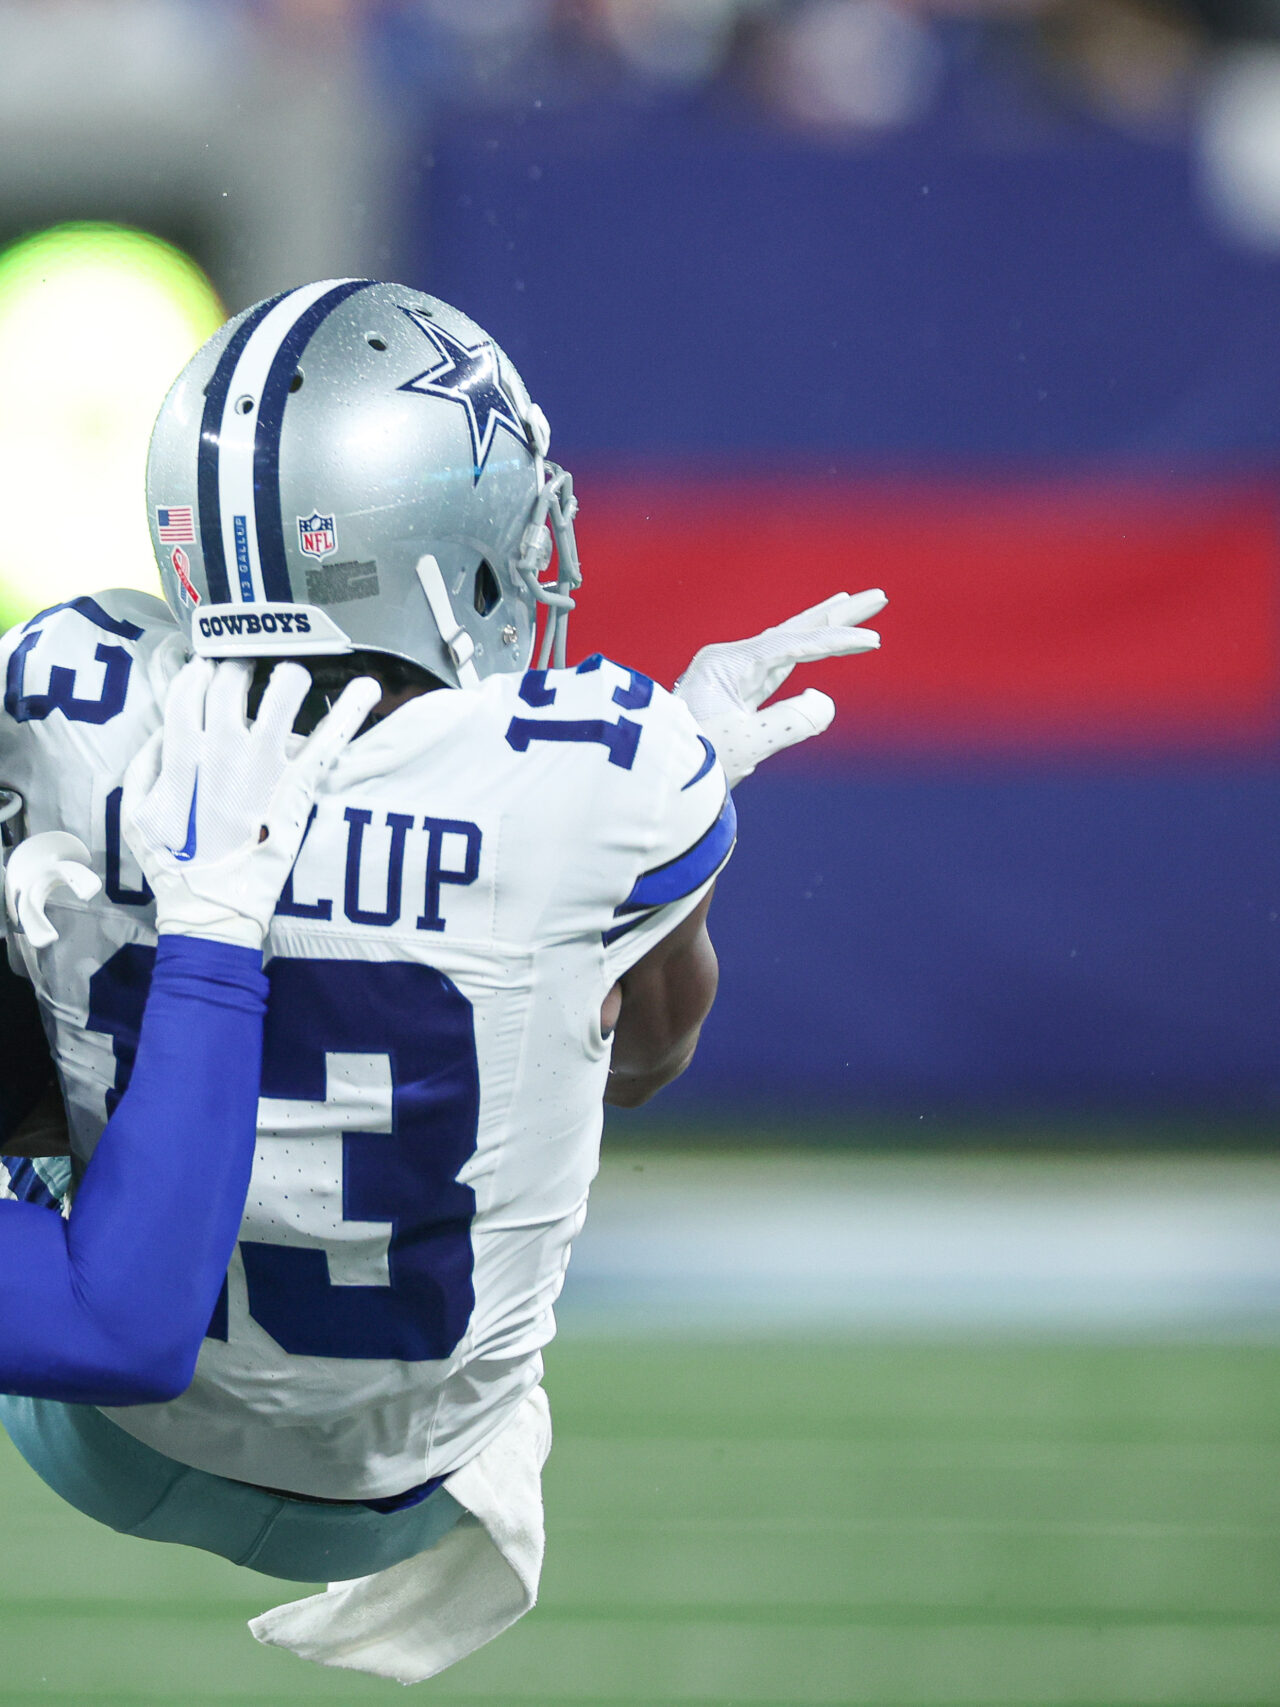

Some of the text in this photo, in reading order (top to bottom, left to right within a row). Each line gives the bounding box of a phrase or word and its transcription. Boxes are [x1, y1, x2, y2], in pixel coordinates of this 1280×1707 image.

[235, 517, 249, 573] GALLUP
[303, 529, 332, 552] NFL
[199, 613, 311, 638] COWBOYS
[105, 786, 483, 932] GLUP
[85, 942, 480, 1362] 3
